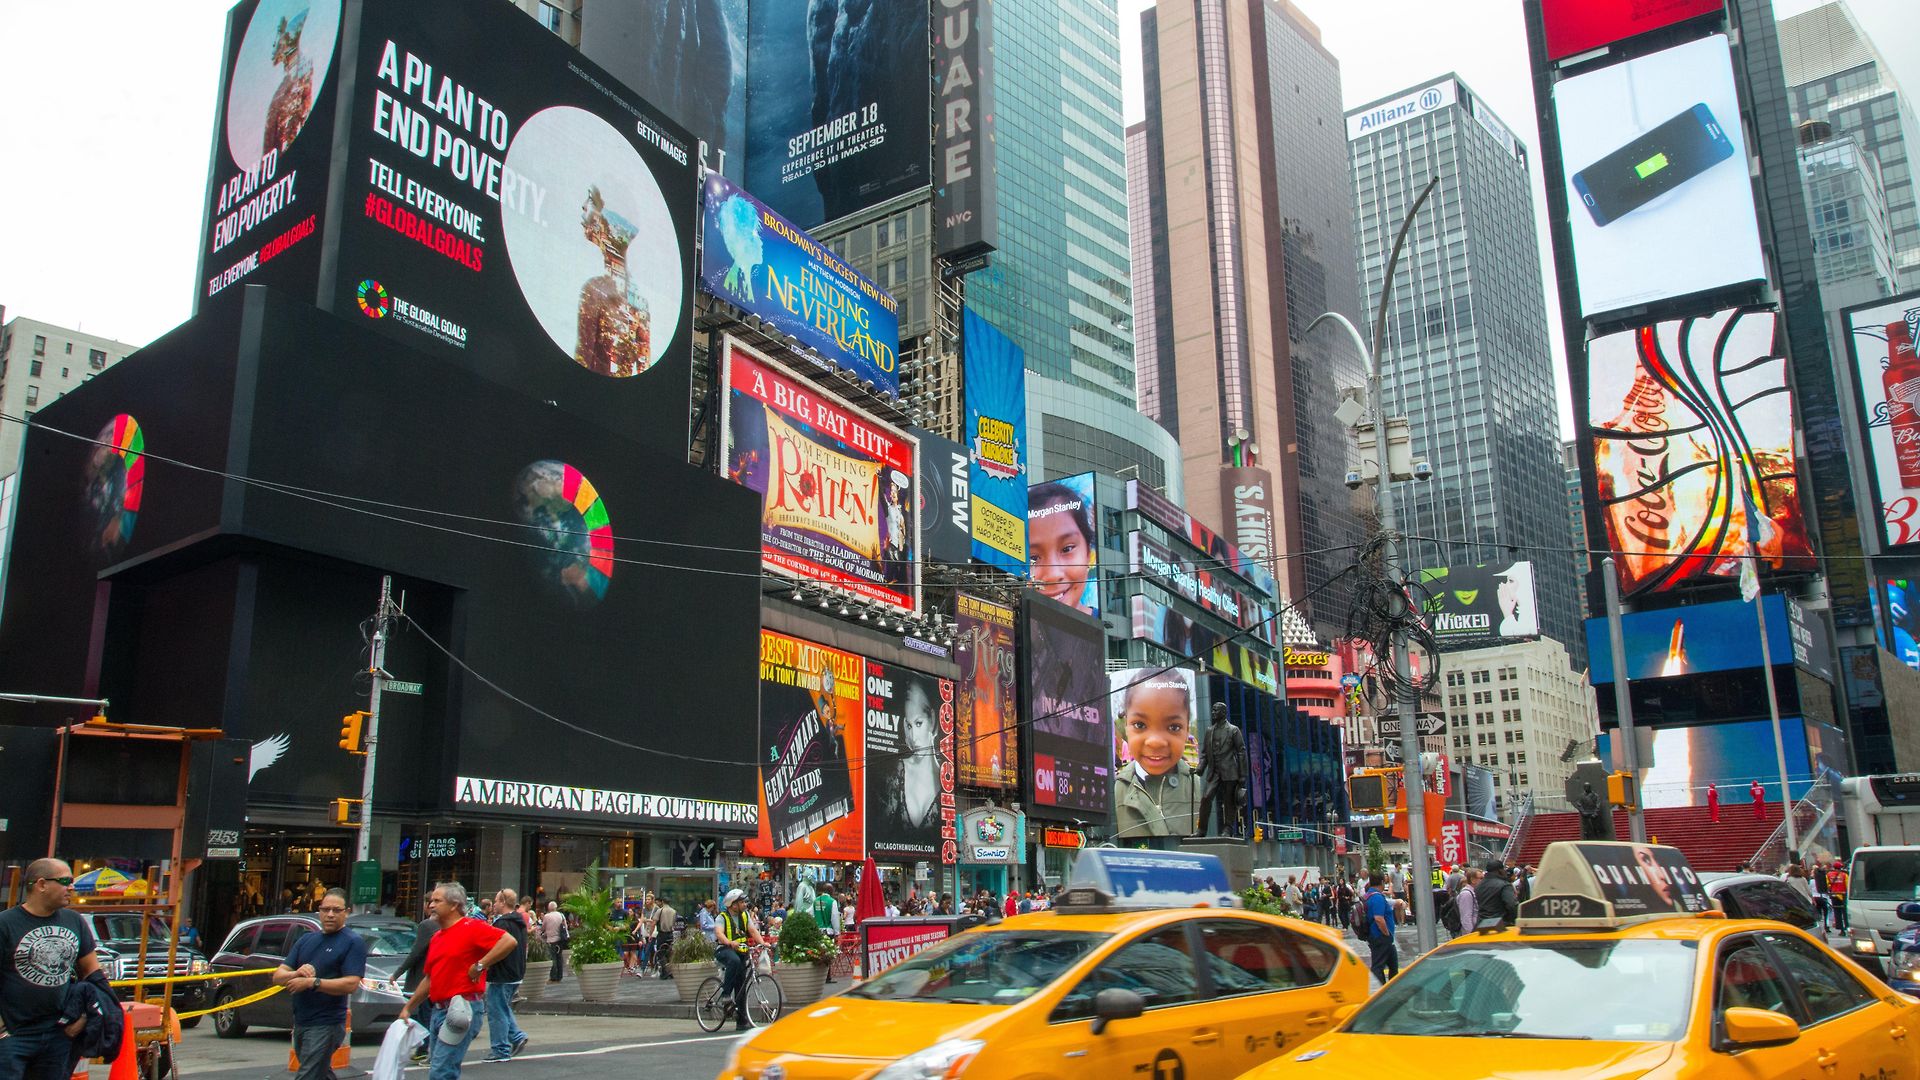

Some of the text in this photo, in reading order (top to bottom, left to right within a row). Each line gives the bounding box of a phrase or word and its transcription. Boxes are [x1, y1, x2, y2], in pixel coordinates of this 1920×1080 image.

[378, 40, 398, 88] A
[404, 52, 474, 132] PLAN
[478, 101, 508, 151] TO
[941, 0, 973, 184] UARE
[789, 102, 878, 158] SEPTEMBER 18
[1360, 101, 1416, 131] Allianz
[374, 89, 547, 227] END POVERTY.
[637, 120, 688, 166] GETTY IMAGES
[782, 123, 887, 174] EXPERIENCE IT IN THEATERS,
[814, 136, 884, 171] 3D AND IMAX 3D
[218, 148, 278, 215] A PLAN TO
[213, 170, 297, 253] END POVERTY.
[370, 158, 485, 243] TELL EVERYONE.
[365, 192, 482, 272] #GLOBALGOALS
[946, 211, 972, 228] NYC
[208, 214, 315, 297] TELL EVERYONE. #GLOBALGOALS
[764, 212, 897, 315] BROADWAY'S BIGGEST NEW HIT!
[800, 265, 869, 329] FINDING
[808, 260, 861, 300] MATTHEW MORRISON
[394, 296, 467, 342] THE GLOBAL GOALS
[766, 264, 895, 373] NEVERLAND
[773, 380, 813, 423] BIG,
[816, 403, 848, 439] FAT
[978, 415, 1014, 445] CELEBRITY
[784, 427, 867, 478] SOMETHING
[981, 440, 1014, 466] KARAOKE
[1624, 374, 1670, 549] Coca-Cola
[951, 452, 969, 533] NEW
[1028, 501, 1081, 519] Morgan Stanley
[981, 506, 1007, 526] OCTOBER
[779, 527, 793, 540] FROM
[794, 532, 804, 543] THE
[804, 535, 825, 551] DIRECTOR
[825, 544, 831, 552] OF
[830, 545, 862, 563] ALADDIN
[976, 525, 991, 539] HARD
[992, 533, 1007, 547] ROCK
[762, 532, 885, 584] THE CO-DIRECTOR OF THE BOOK OF MORMON
[774, 554, 786, 565] THE
[787, 557, 810, 574] CORNER
[810, 566, 819, 577] ON
[1143, 545, 1239, 618] Morgan Stanley Healthy Cities
[797, 643, 860, 684] MUSICAL!
[866, 662, 884, 678] THE
[388, 681, 421, 693] BROADWAY
[775, 667, 796, 686] TONY
[796, 671, 821, 692] AWARD
[834, 681, 860, 701] WINNER
[867, 676, 893, 698] ONE
[1145, 681, 1188, 691] Morgan Stanley
[866, 695, 884, 710] THE
[1084, 706, 1100, 724] 3D
[867, 709, 900, 732] ONLY
[765, 709, 820, 807] GENTLEMAN'S
[770, 745, 780, 762] A
[938, 678, 957, 864] CHICAGO
[790, 768, 822, 798] GUIDE
[1035, 768, 1054, 792] CNN
[1058, 777, 1069, 795] 88
[461, 779, 758, 825] AMERICAN EAGLE OUTFITTERS
[874, 842, 935, 852] CHICAGOTHEMUSICAL.COM
[977, 848, 1006, 858] Sanrio
[1442, 824, 1461, 862] tkts
[1592, 864, 1697, 885] QUANTICO
[1541, 899, 1581, 916] 1P82
[16, 926, 53, 956] RANCID
[921, 933, 931, 941] FOUR
[930, 930, 946, 940] SEASONS
[868, 945, 910, 978] JERSEY
